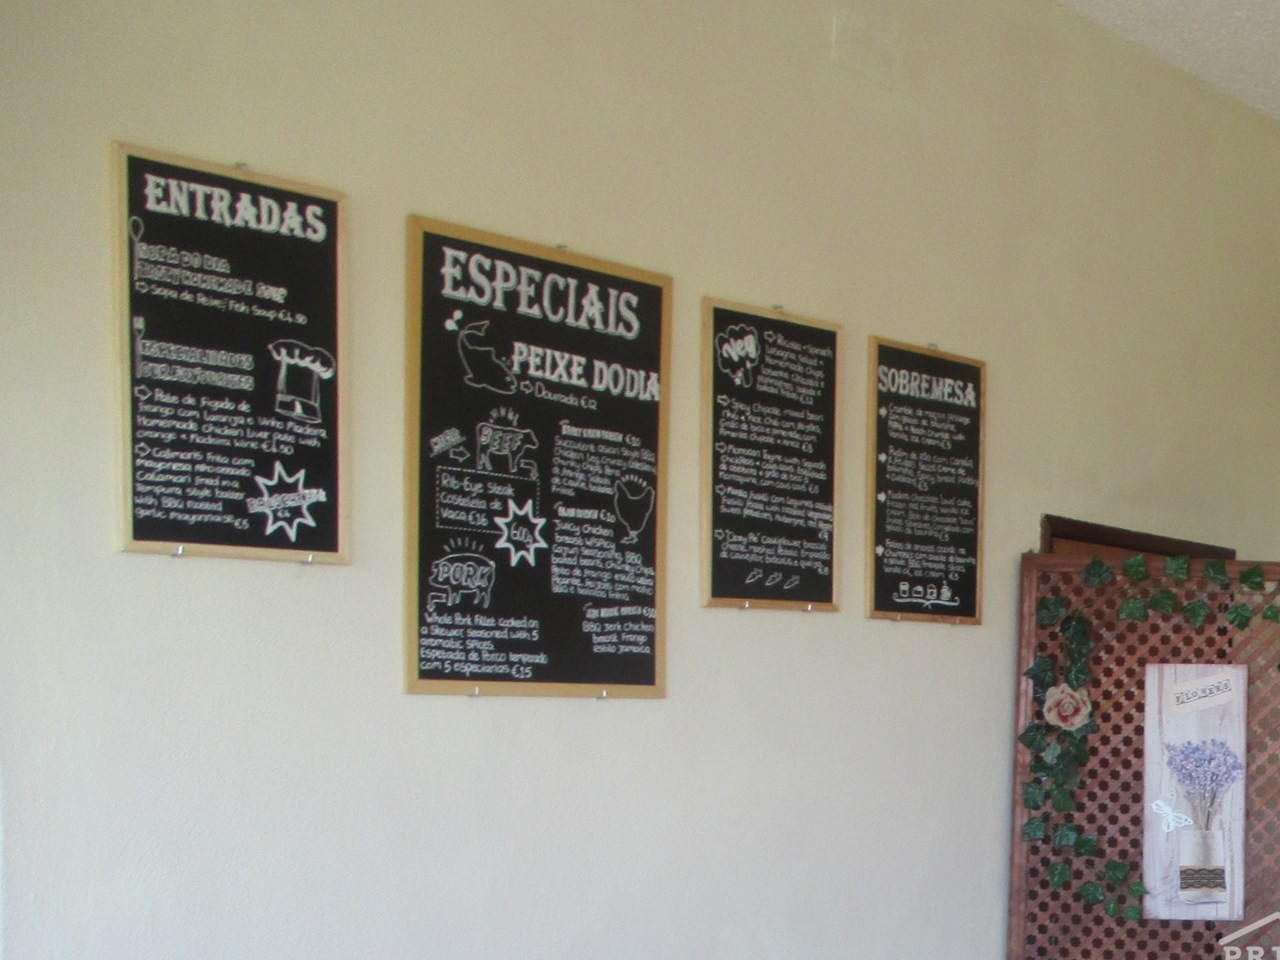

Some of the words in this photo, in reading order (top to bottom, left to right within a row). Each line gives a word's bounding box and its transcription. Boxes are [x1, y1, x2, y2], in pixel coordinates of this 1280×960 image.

[145, 173, 327, 242] ENTRADAS
[441, 246, 640, 340] ESPECIAIS
[511, 341, 588, 388] PEIXE
[878, 365, 976, 408] SOBREMESA
[480, 426, 524, 452] BEEF
[438, 561, 492, 588] PORK
[532, 629, 539, 641] 5
[443, 660, 452, 673] 5
[511, 664, 532, 679] €15
[1175, 680, 1230, 703] FLOWERS
